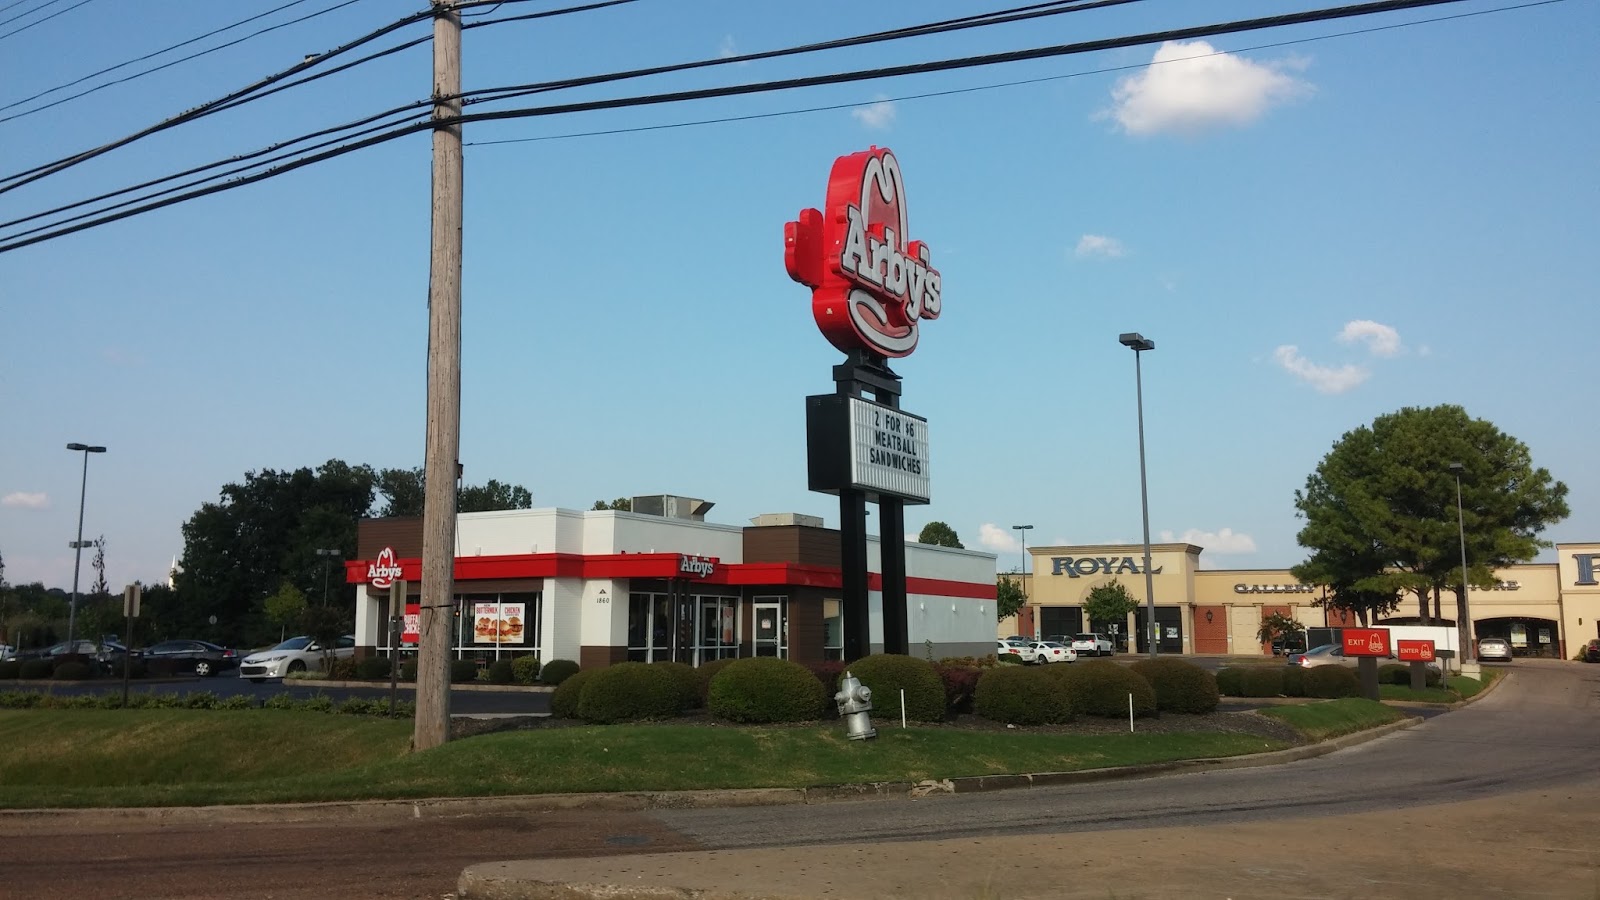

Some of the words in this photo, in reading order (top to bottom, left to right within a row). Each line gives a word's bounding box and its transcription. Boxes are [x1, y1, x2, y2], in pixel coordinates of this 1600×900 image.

[842, 203, 941, 322] Arby's
[875, 411, 880, 427] 2
[885, 414, 901, 433] FOR
[905, 422, 915, 437] $6
[875, 430, 916, 456] MEATBALL
[869, 447, 921, 475] SANDWICHES
[367, 563, 402, 581] Arby's
[680, 555, 714, 578] Arby's
[1051, 556, 1163, 578] ROYAL
[1234, 583, 1315, 594] GALLERY
[1347, 638, 1366, 647] EXIT
